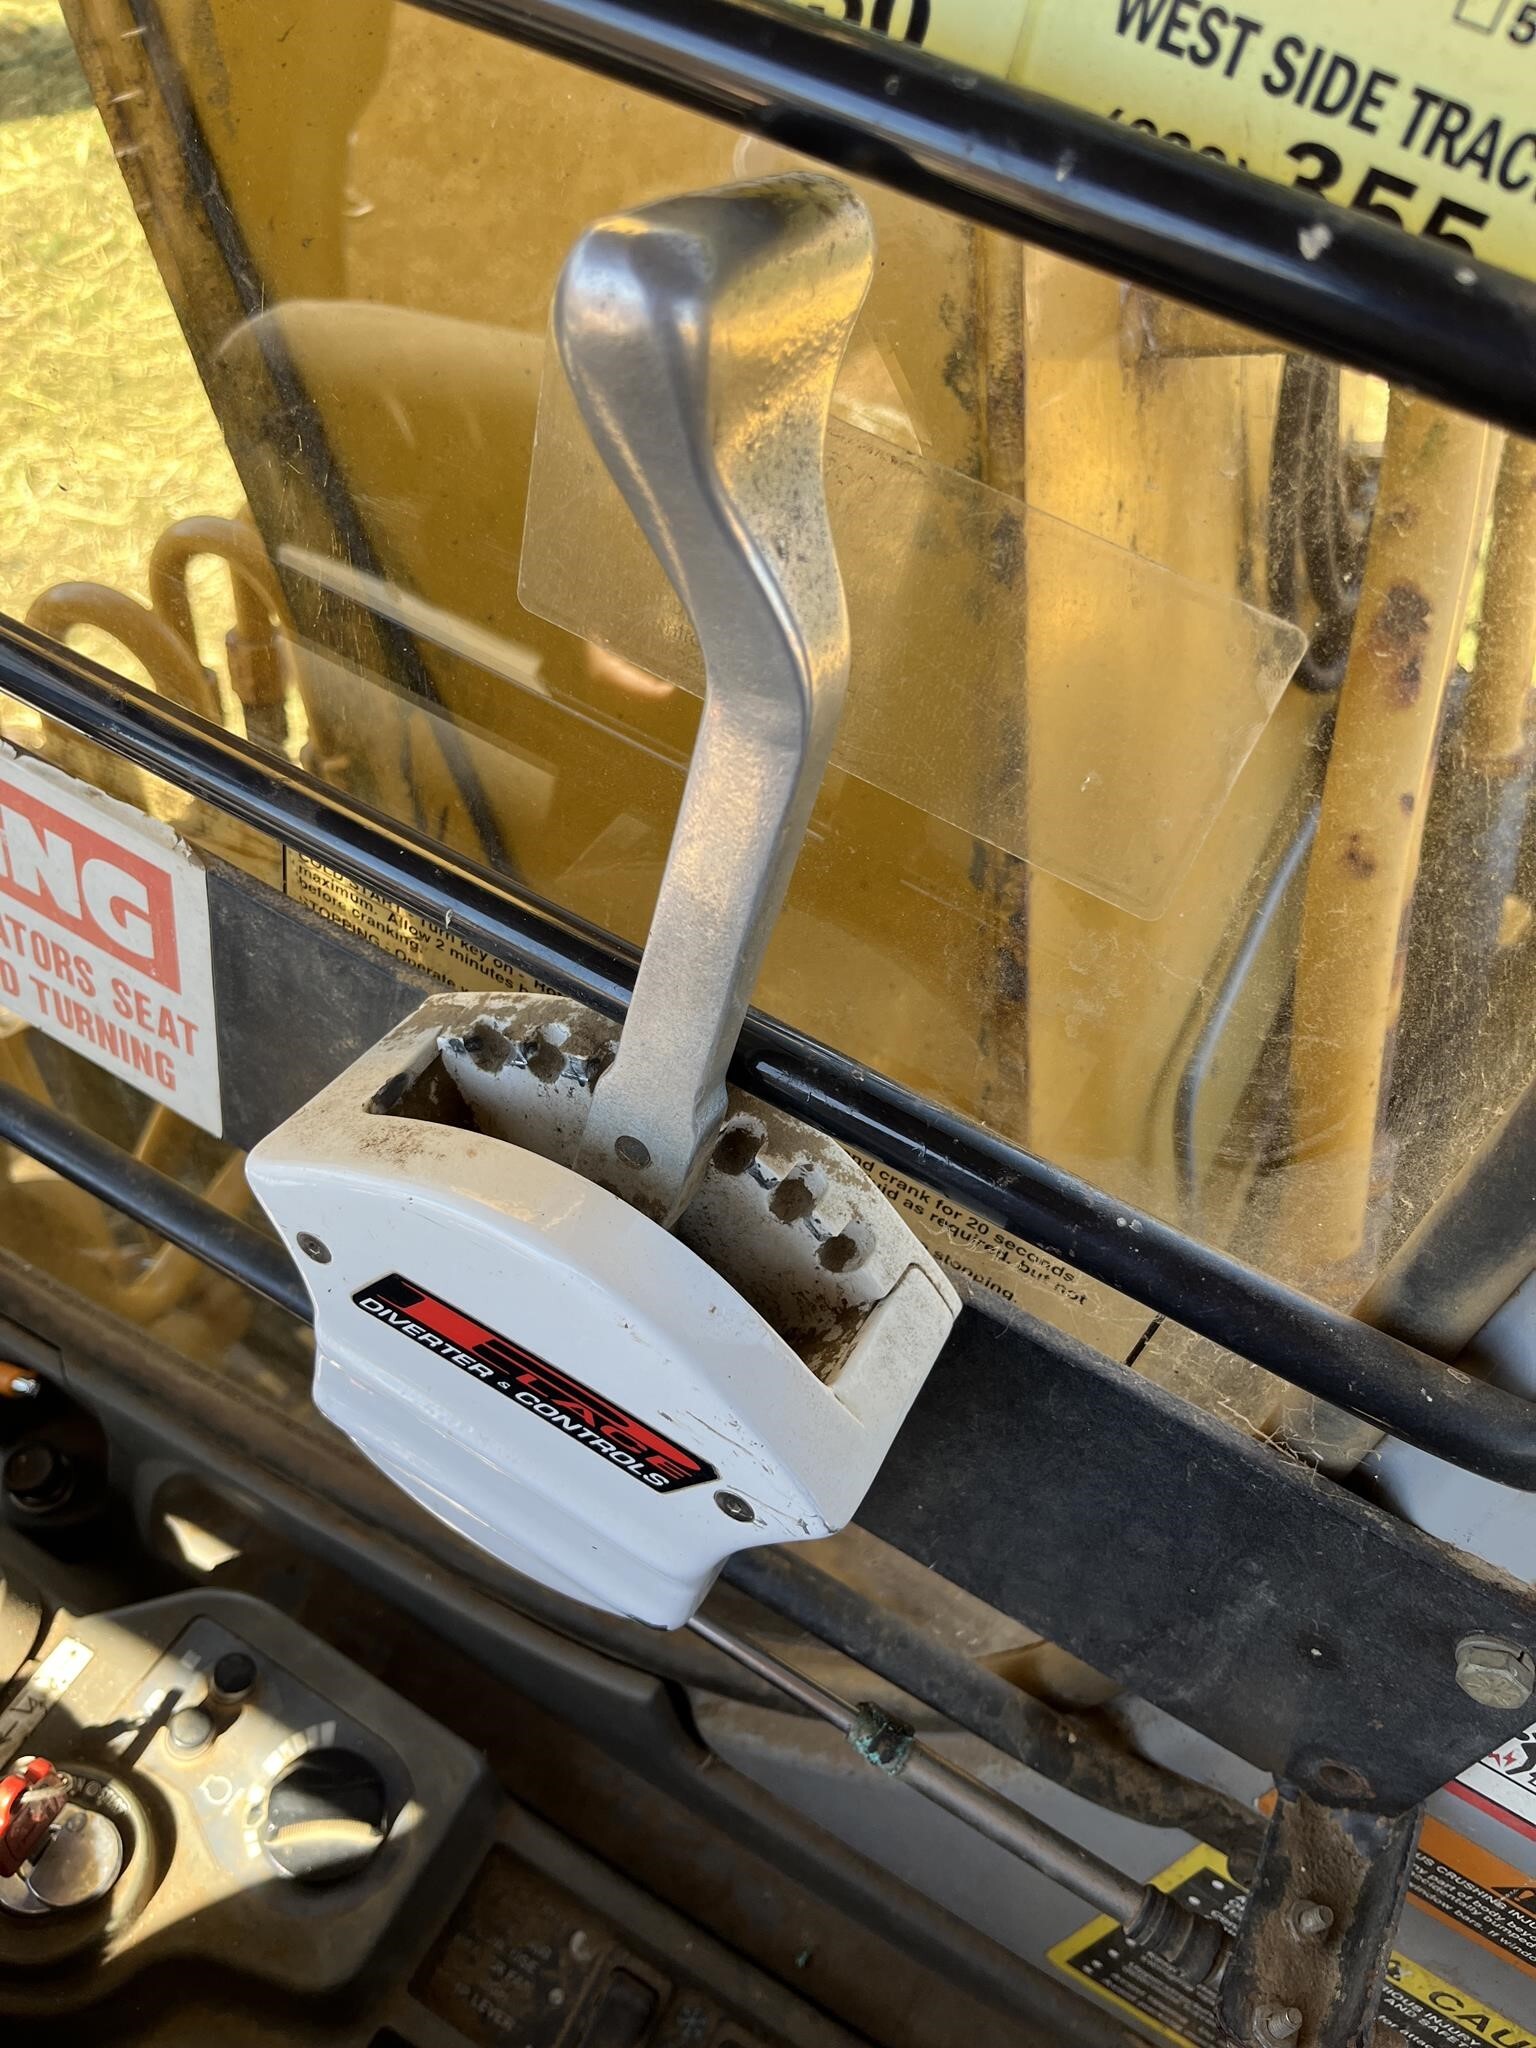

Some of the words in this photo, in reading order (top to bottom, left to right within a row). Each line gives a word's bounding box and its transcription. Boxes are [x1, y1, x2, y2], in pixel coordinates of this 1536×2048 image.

[1115, 0, 1263, 78] WEST
[1261, 36, 1399, 136] SIDE
[1400, 85, 1536, 203] TRAC
[299, 876, 347, 911] before
[352, 908, 423, 954] cranking.
[299, 865, 378, 915] maximum.
[388, 912, 431, 943] Allow
[436, 938, 445, 951] 2
[450, 949, 514, 989] minutes
[460, 937, 490, 961] key
[493, 957, 514, 976] on
[29, 973, 177, 1092] TURNING
[111, 976, 199, 1057] SEAT
[849, 1151, 875, 1173] nd
[879, 1170, 931, 1204] crank
[936, 1199, 962, 1220] for
[965, 1216, 990, 1236] 20
[993, 1233, 1076, 1283] seconds
[903, 1199, 924, 1216] as
[1018, 1260, 1050, 1281] but
[1054, 1282, 1088, 1306] not
[358, 1297, 495, 1379] DIVERTER
[497, 1380, 511, 1390] &
[514, 1391, 670, 1487] CONTROLS
[1427, 1874, 1457, 1892] part
[1457, 1891, 1474, 1901] of
[1473, 1900, 1506, 1922] body
[1436, 1865, 1507, 1910] CRUSHING
[1483, 1914, 1536, 1949] bumped
[1384, 1998, 1418, 2019] AND
[1418, 2018, 1472, 2048] SAFET
[1424, 2012, 1481, 2046] INJURY
[1428, 1990, 1531, 2048] CAU
